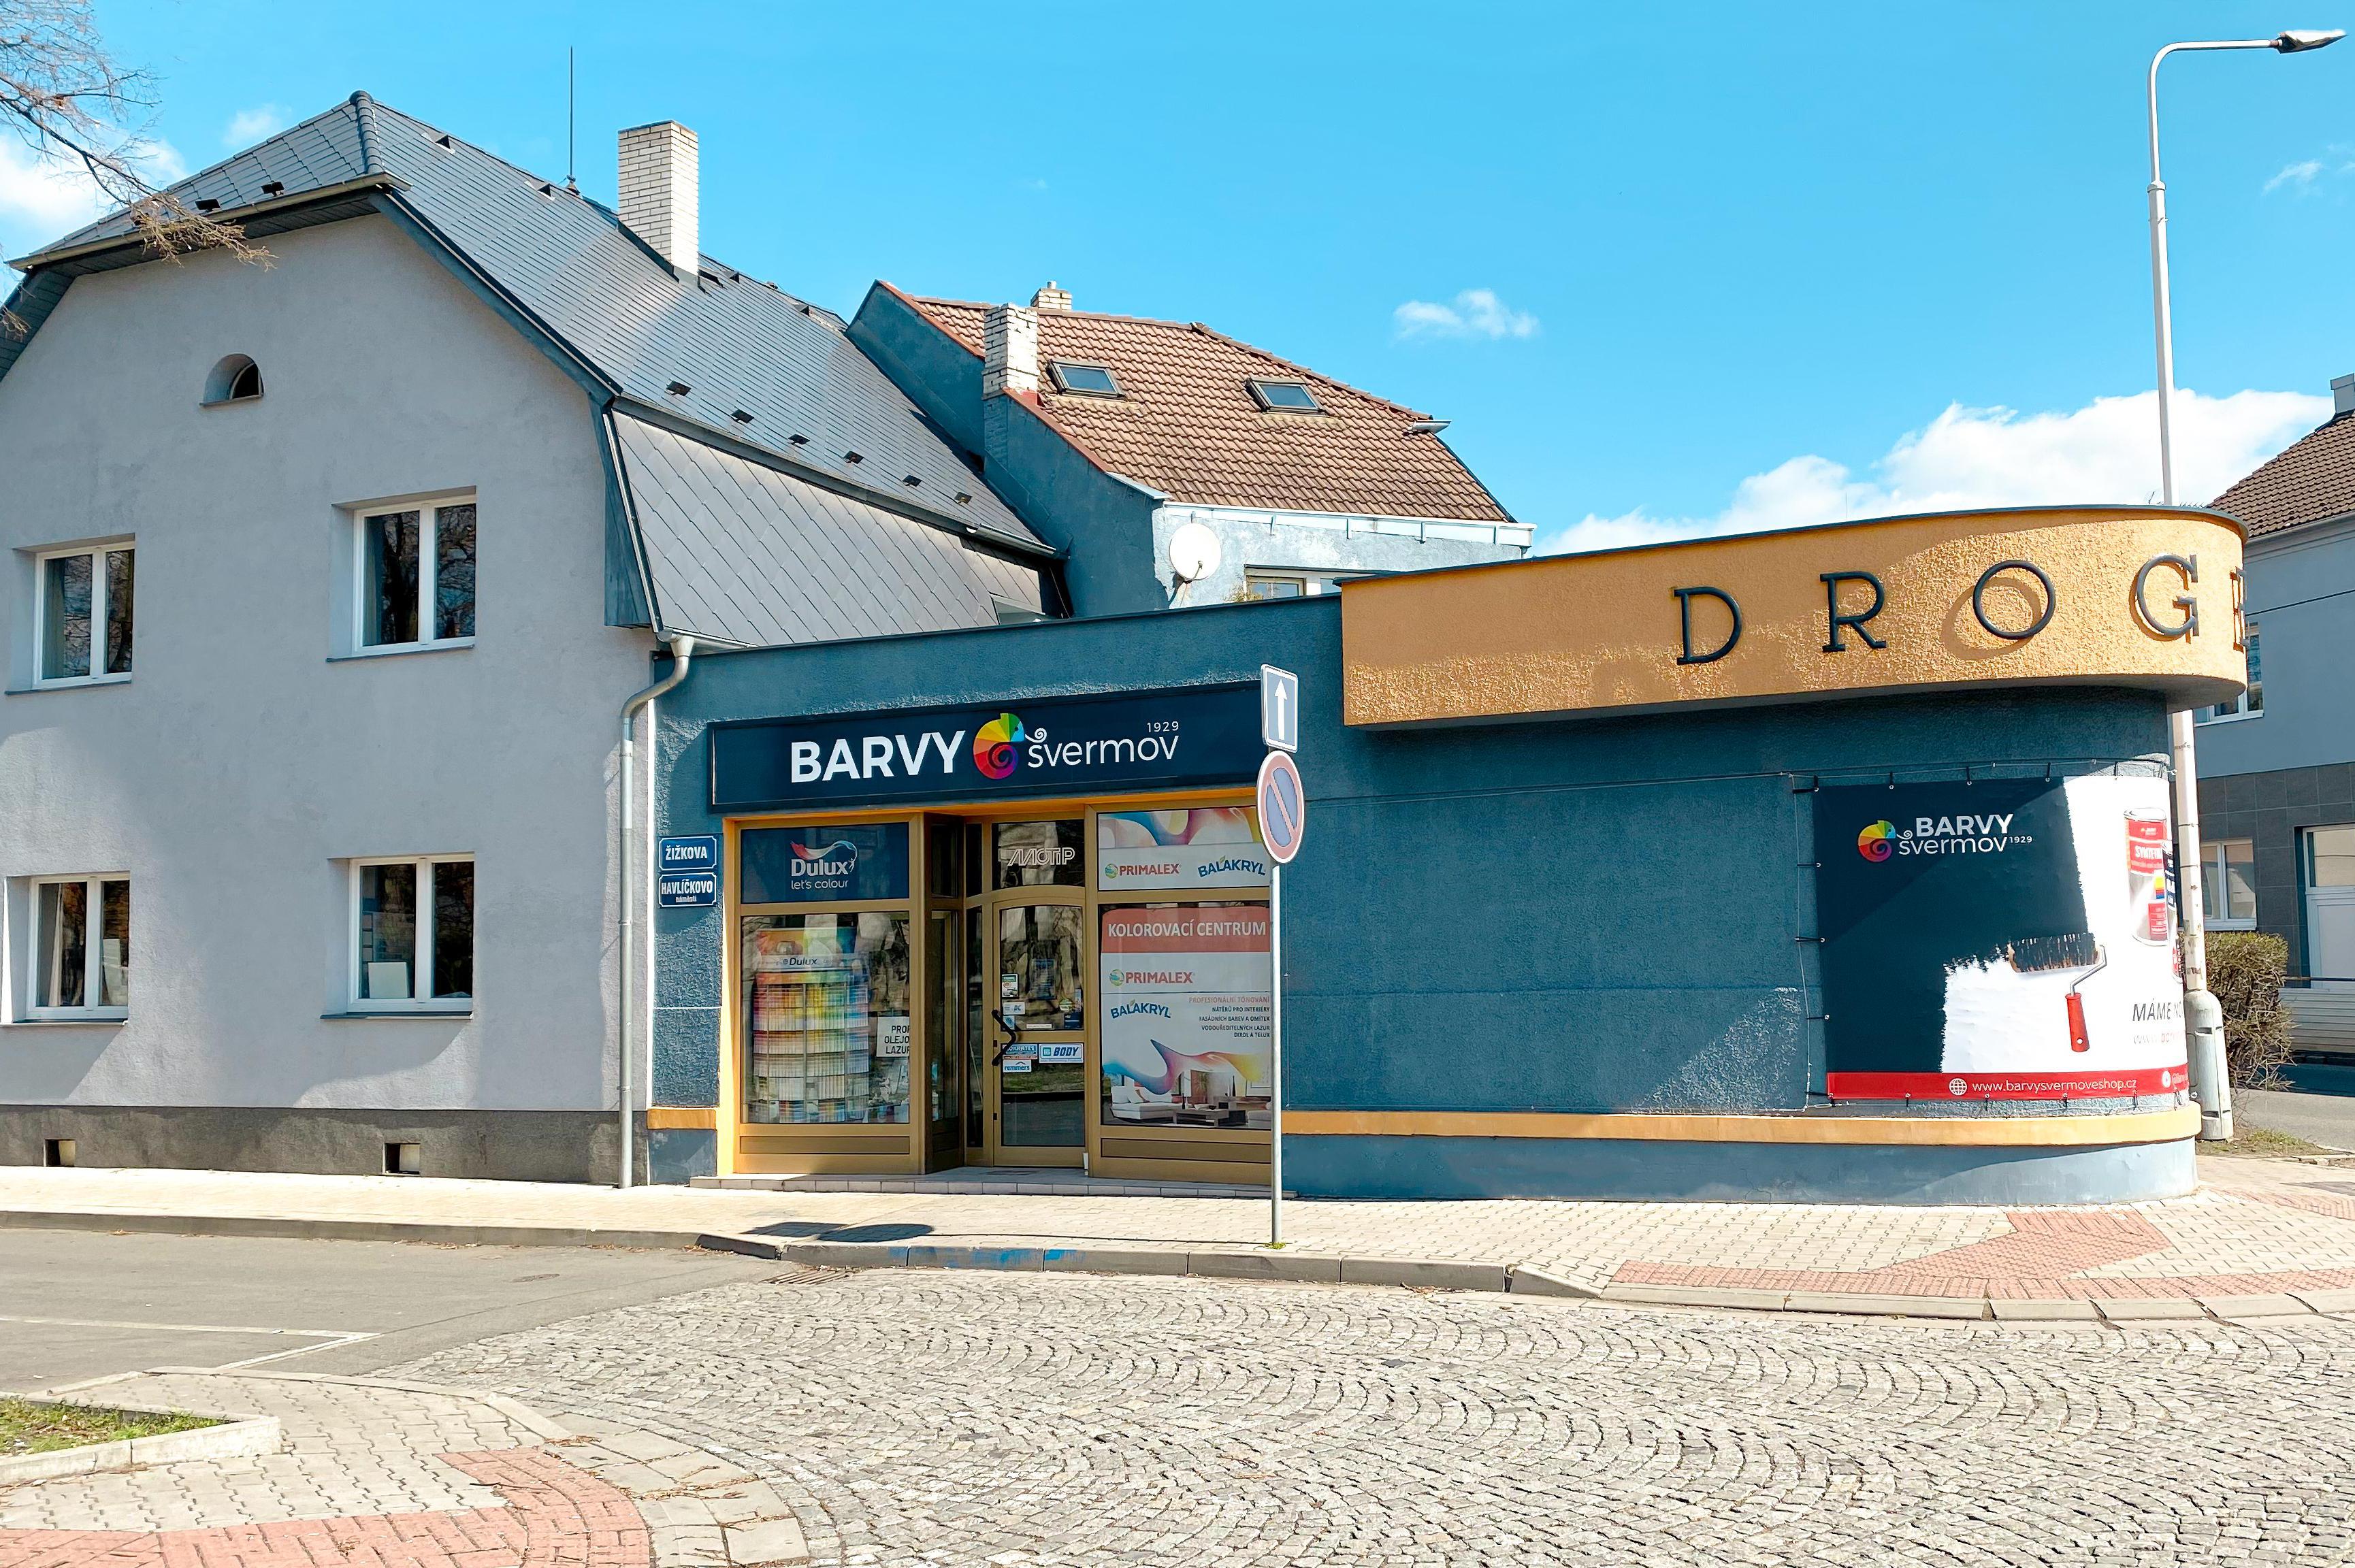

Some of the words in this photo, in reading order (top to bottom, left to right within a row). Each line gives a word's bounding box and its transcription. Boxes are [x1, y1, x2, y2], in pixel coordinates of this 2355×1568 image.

[1146, 720, 1180, 733] 1929
[791, 730, 966, 783] BARVY
[1916, 814, 2013, 837] BARVY
[2009, 836, 2032, 844] 1929
[665, 845, 708, 861] ŽIŽKOVA
[791, 859, 849, 877] Dulux
[1119, 864, 1180, 877] PRIMALEX
[1197, 858, 1266, 878] BALAKRYL
[661, 879, 713, 895] HAVLÍČKOVO
[791, 881, 812, 889] let's
[814, 880, 849, 889] colour
[1108, 919, 1195, 937] KOLOROVACÍ
[1197, 921, 1266, 936] CENTRUM
[789, 957, 817, 966] Dulux
[1125, 971, 1192, 983] PRIMALEX
[1110, 1002, 1171, 1019] BALAKRYL
[2132, 998, 2171, 1022] MÁME
[1053, 1047, 1079, 1057] BODY
[1972, 1078, 2137, 1094] www.barvysvermoveshop.cz
